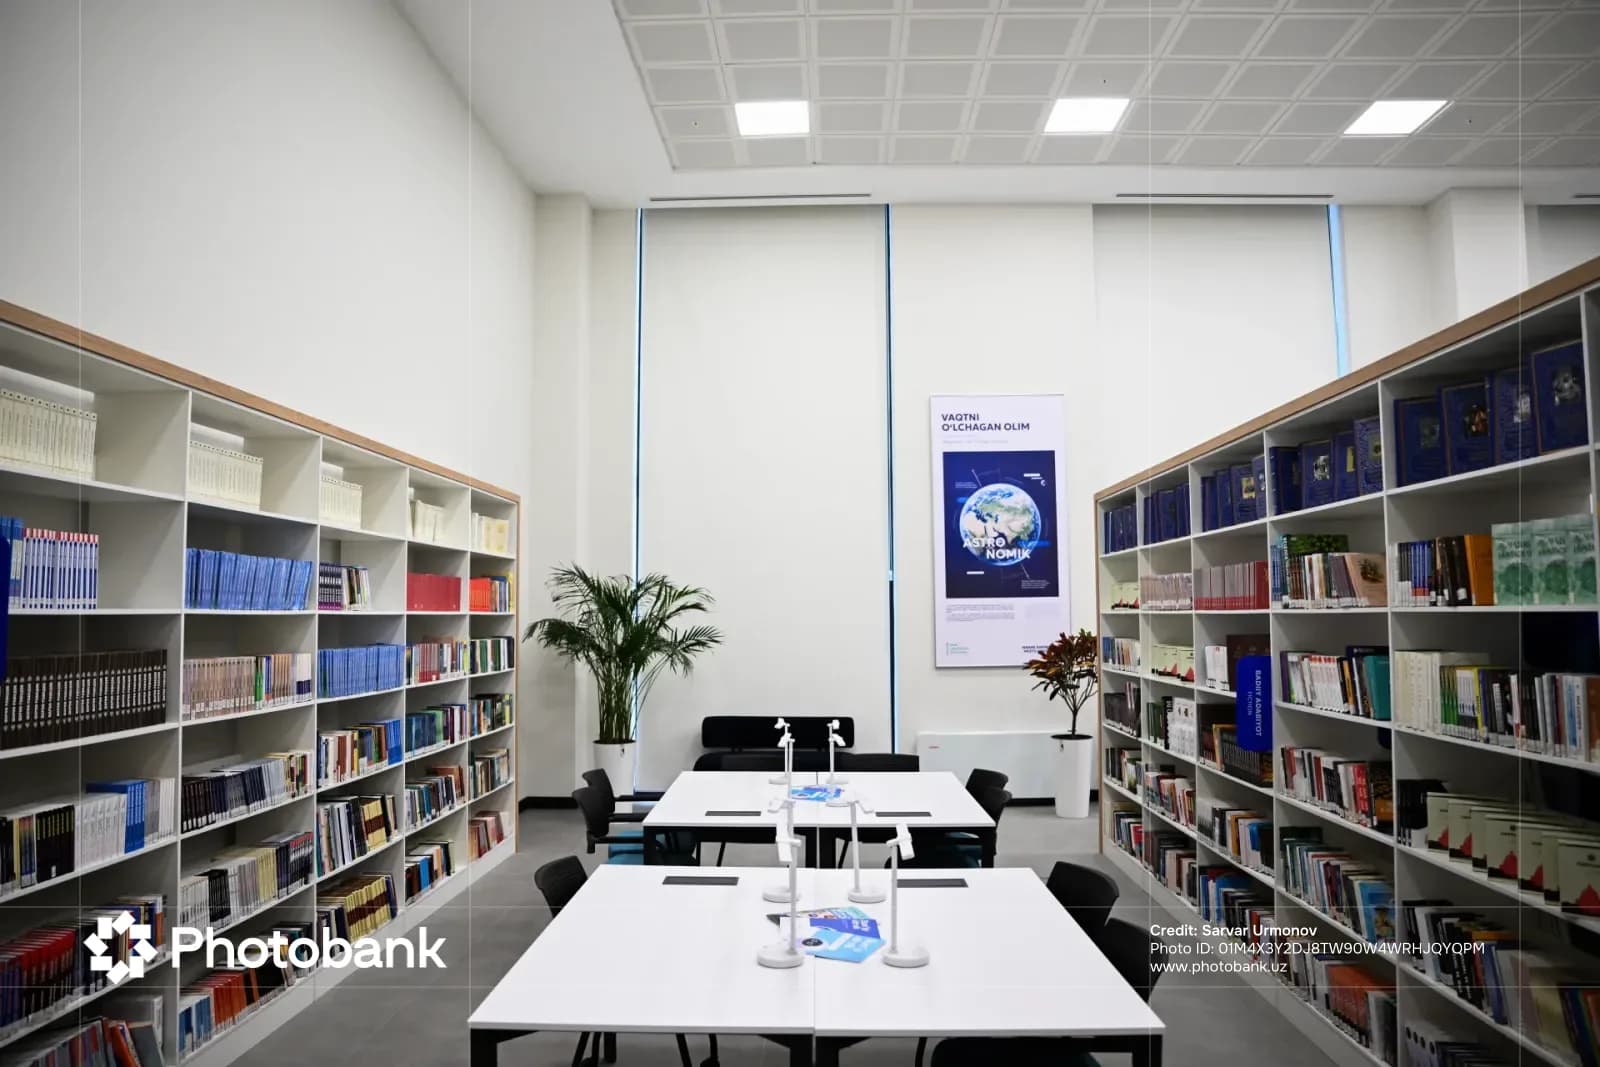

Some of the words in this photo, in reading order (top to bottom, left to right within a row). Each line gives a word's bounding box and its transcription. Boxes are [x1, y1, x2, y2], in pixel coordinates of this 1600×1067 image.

[941, 413, 980, 422] VAQTNI
[1003, 423, 1030, 431] OLIM
[962, 537, 1006, 549] ASTRO
[986, 548, 1031, 560] NOMIK
